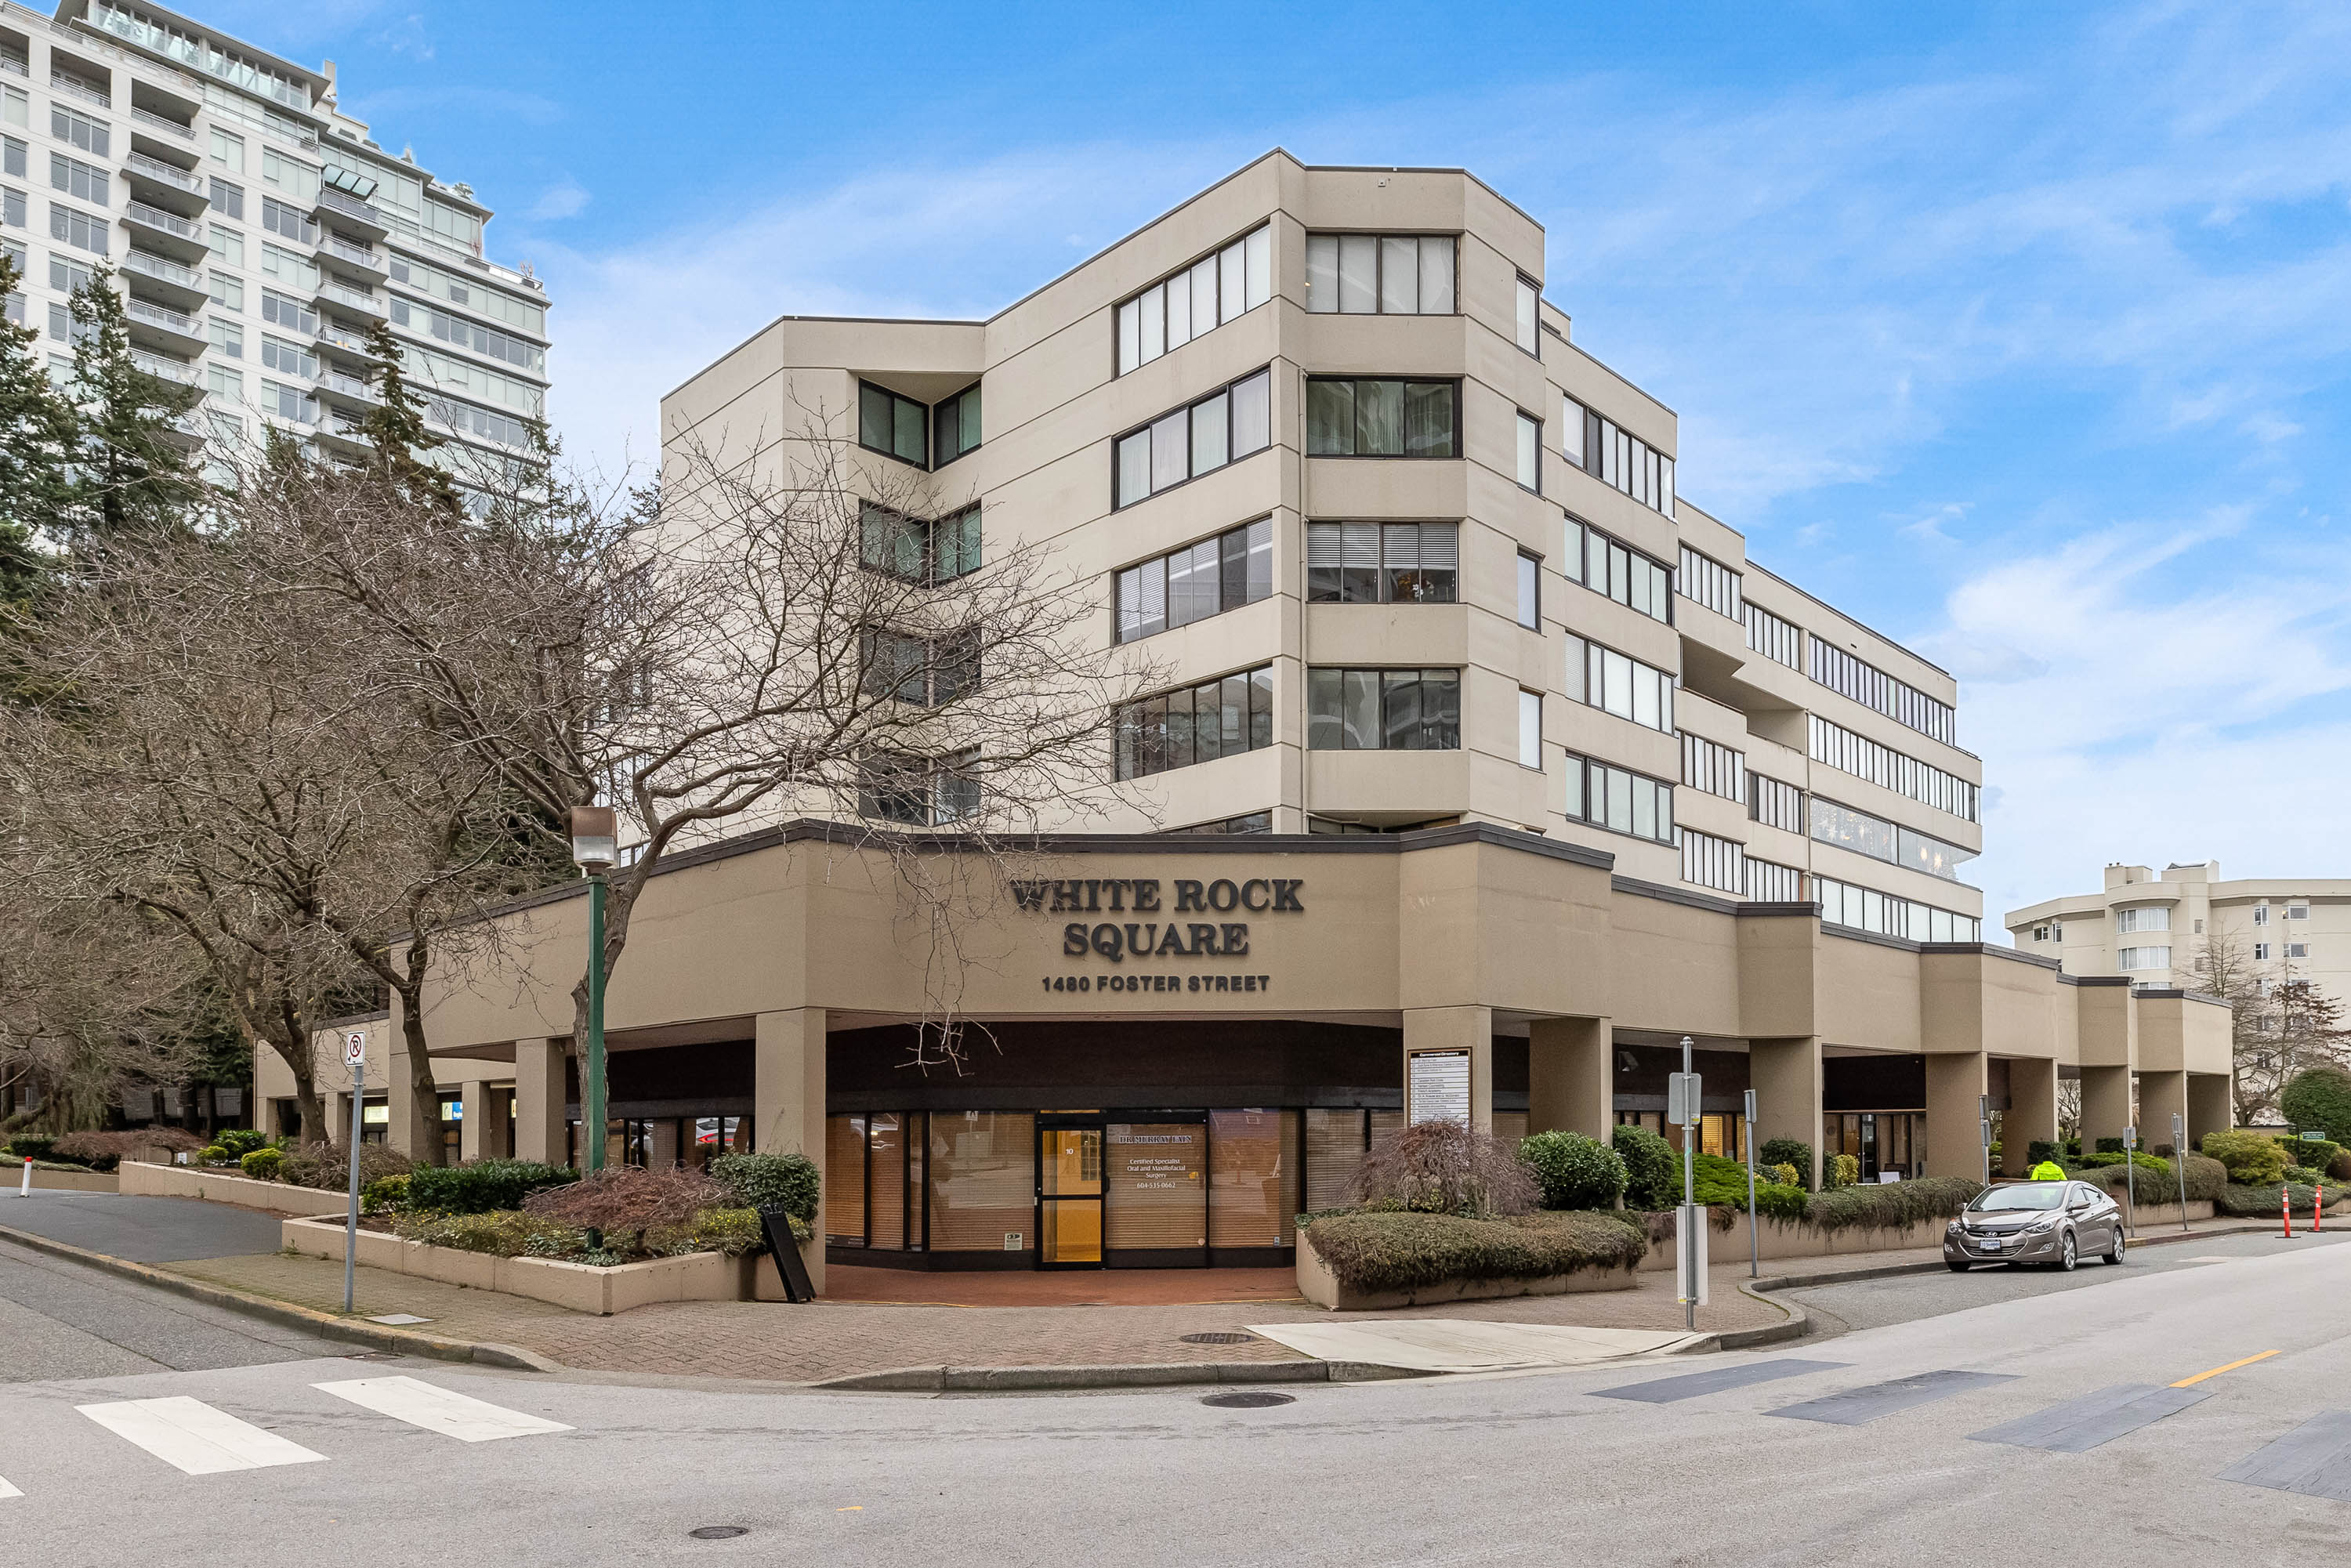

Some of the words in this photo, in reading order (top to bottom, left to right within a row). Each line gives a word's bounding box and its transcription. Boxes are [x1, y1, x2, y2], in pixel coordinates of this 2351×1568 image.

[1009, 879, 1160, 911] WHITE
[1173, 878, 1304, 911] ROCK
[1063, 923, 1248, 962] SQUARE
[1042, 976, 1090, 991] 1480
[1097, 976, 1180, 991] FOSTER
[1188, 975, 1270, 991] STREET
